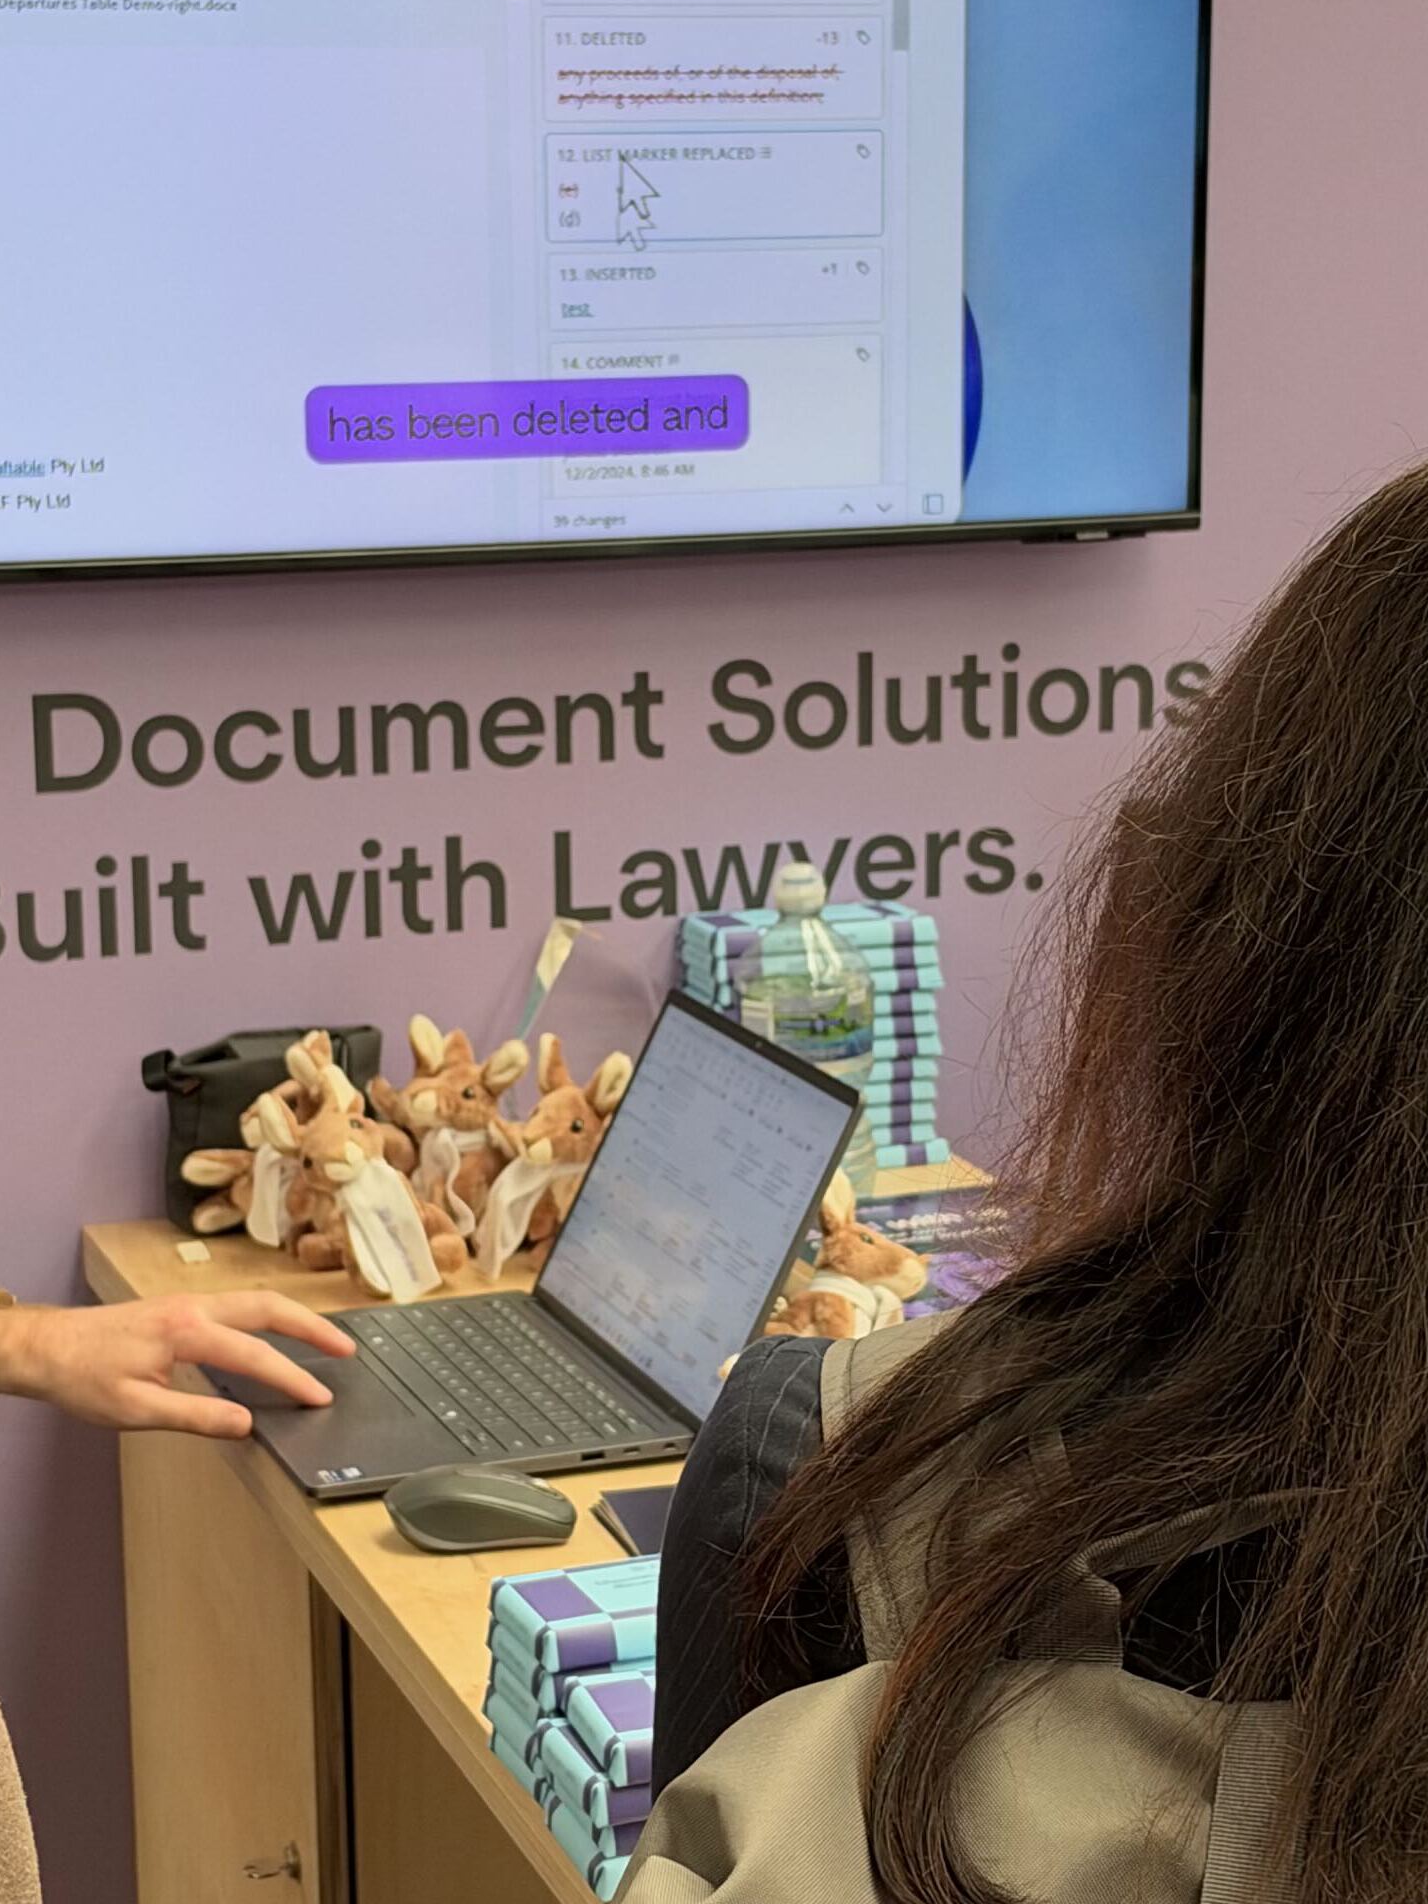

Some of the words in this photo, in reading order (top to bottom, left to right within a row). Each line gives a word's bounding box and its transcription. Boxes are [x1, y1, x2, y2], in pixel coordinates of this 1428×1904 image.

[581, 32, 646, 46] DELETED
[583, 148, 612, 162] LIST
[682, 145, 756, 161] REPLACED
[559, 210, 581, 228] (d)
[585, 266, 657, 282] INSERTED
[586, 354, 663, 371] COMMENT
[329, 406, 395, 442] has
[408, 403, 500, 440] been
[512, 397, 650, 437] deleted
[662, 394, 730, 431] and
[51, 457, 76, 476] Pty
[81, 457, 105, 473] Ltd
[17, 494, 42, 512] Pty
[46, 493, 72, 509] Ltd
[573, 514, 627, 529] changes
[31, 679, 665, 802] Document
[704, 641, 1214, 757] Solutions
[247, 837, 509, 944] with
[553, 827, 1045, 923] Lawyers.
